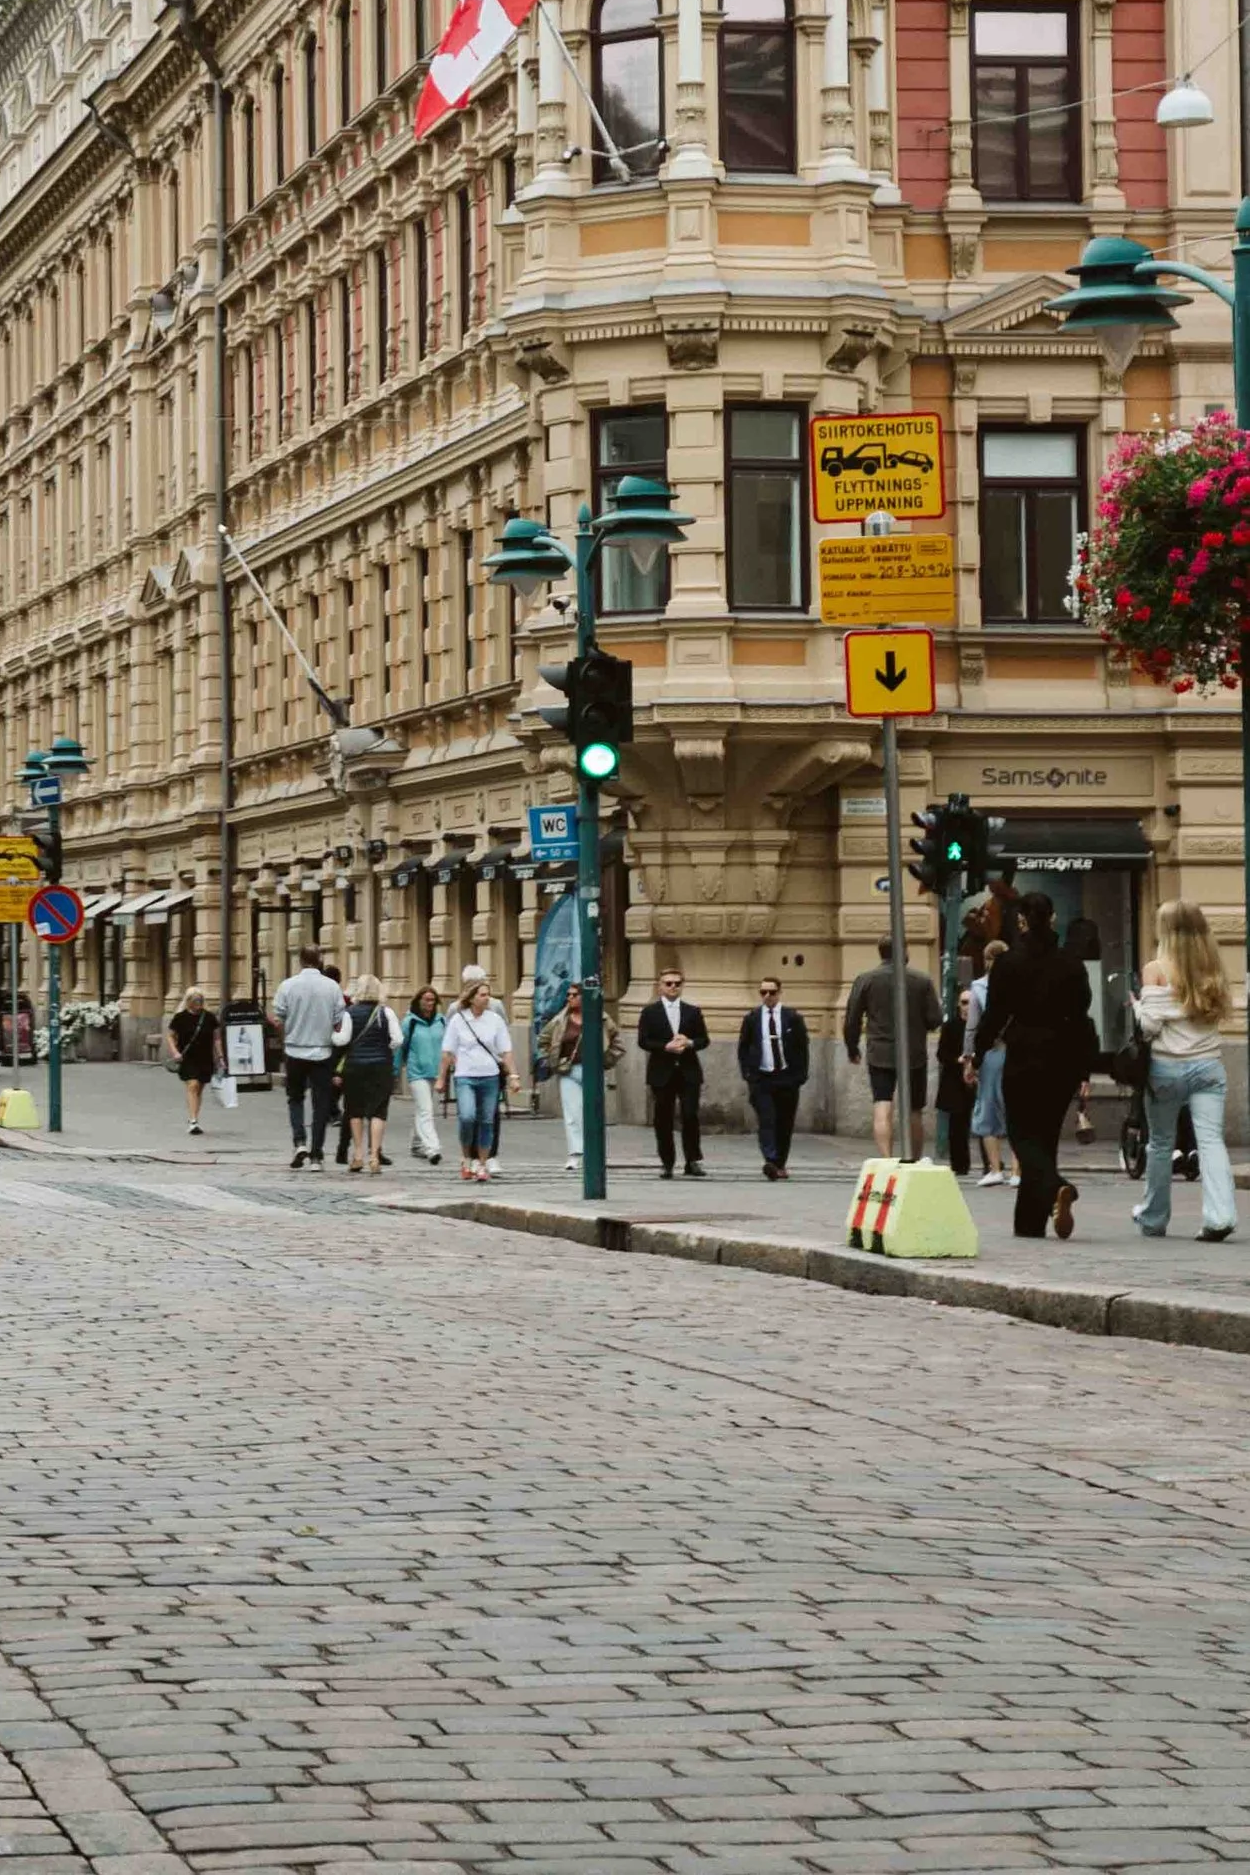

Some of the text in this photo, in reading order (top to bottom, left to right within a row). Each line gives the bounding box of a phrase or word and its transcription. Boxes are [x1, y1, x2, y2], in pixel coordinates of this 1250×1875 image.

[818, 421, 934, 439] SIIRTOKEHOTUS
[834, 477, 929, 494] FLYTTNINGS-
[835, 496, 923, 512] UPPMANING
[981, 767, 1108, 788] Samsonite
[542, 818, 566, 832] WC
[1016, 857, 1093, 871] Samsonite
